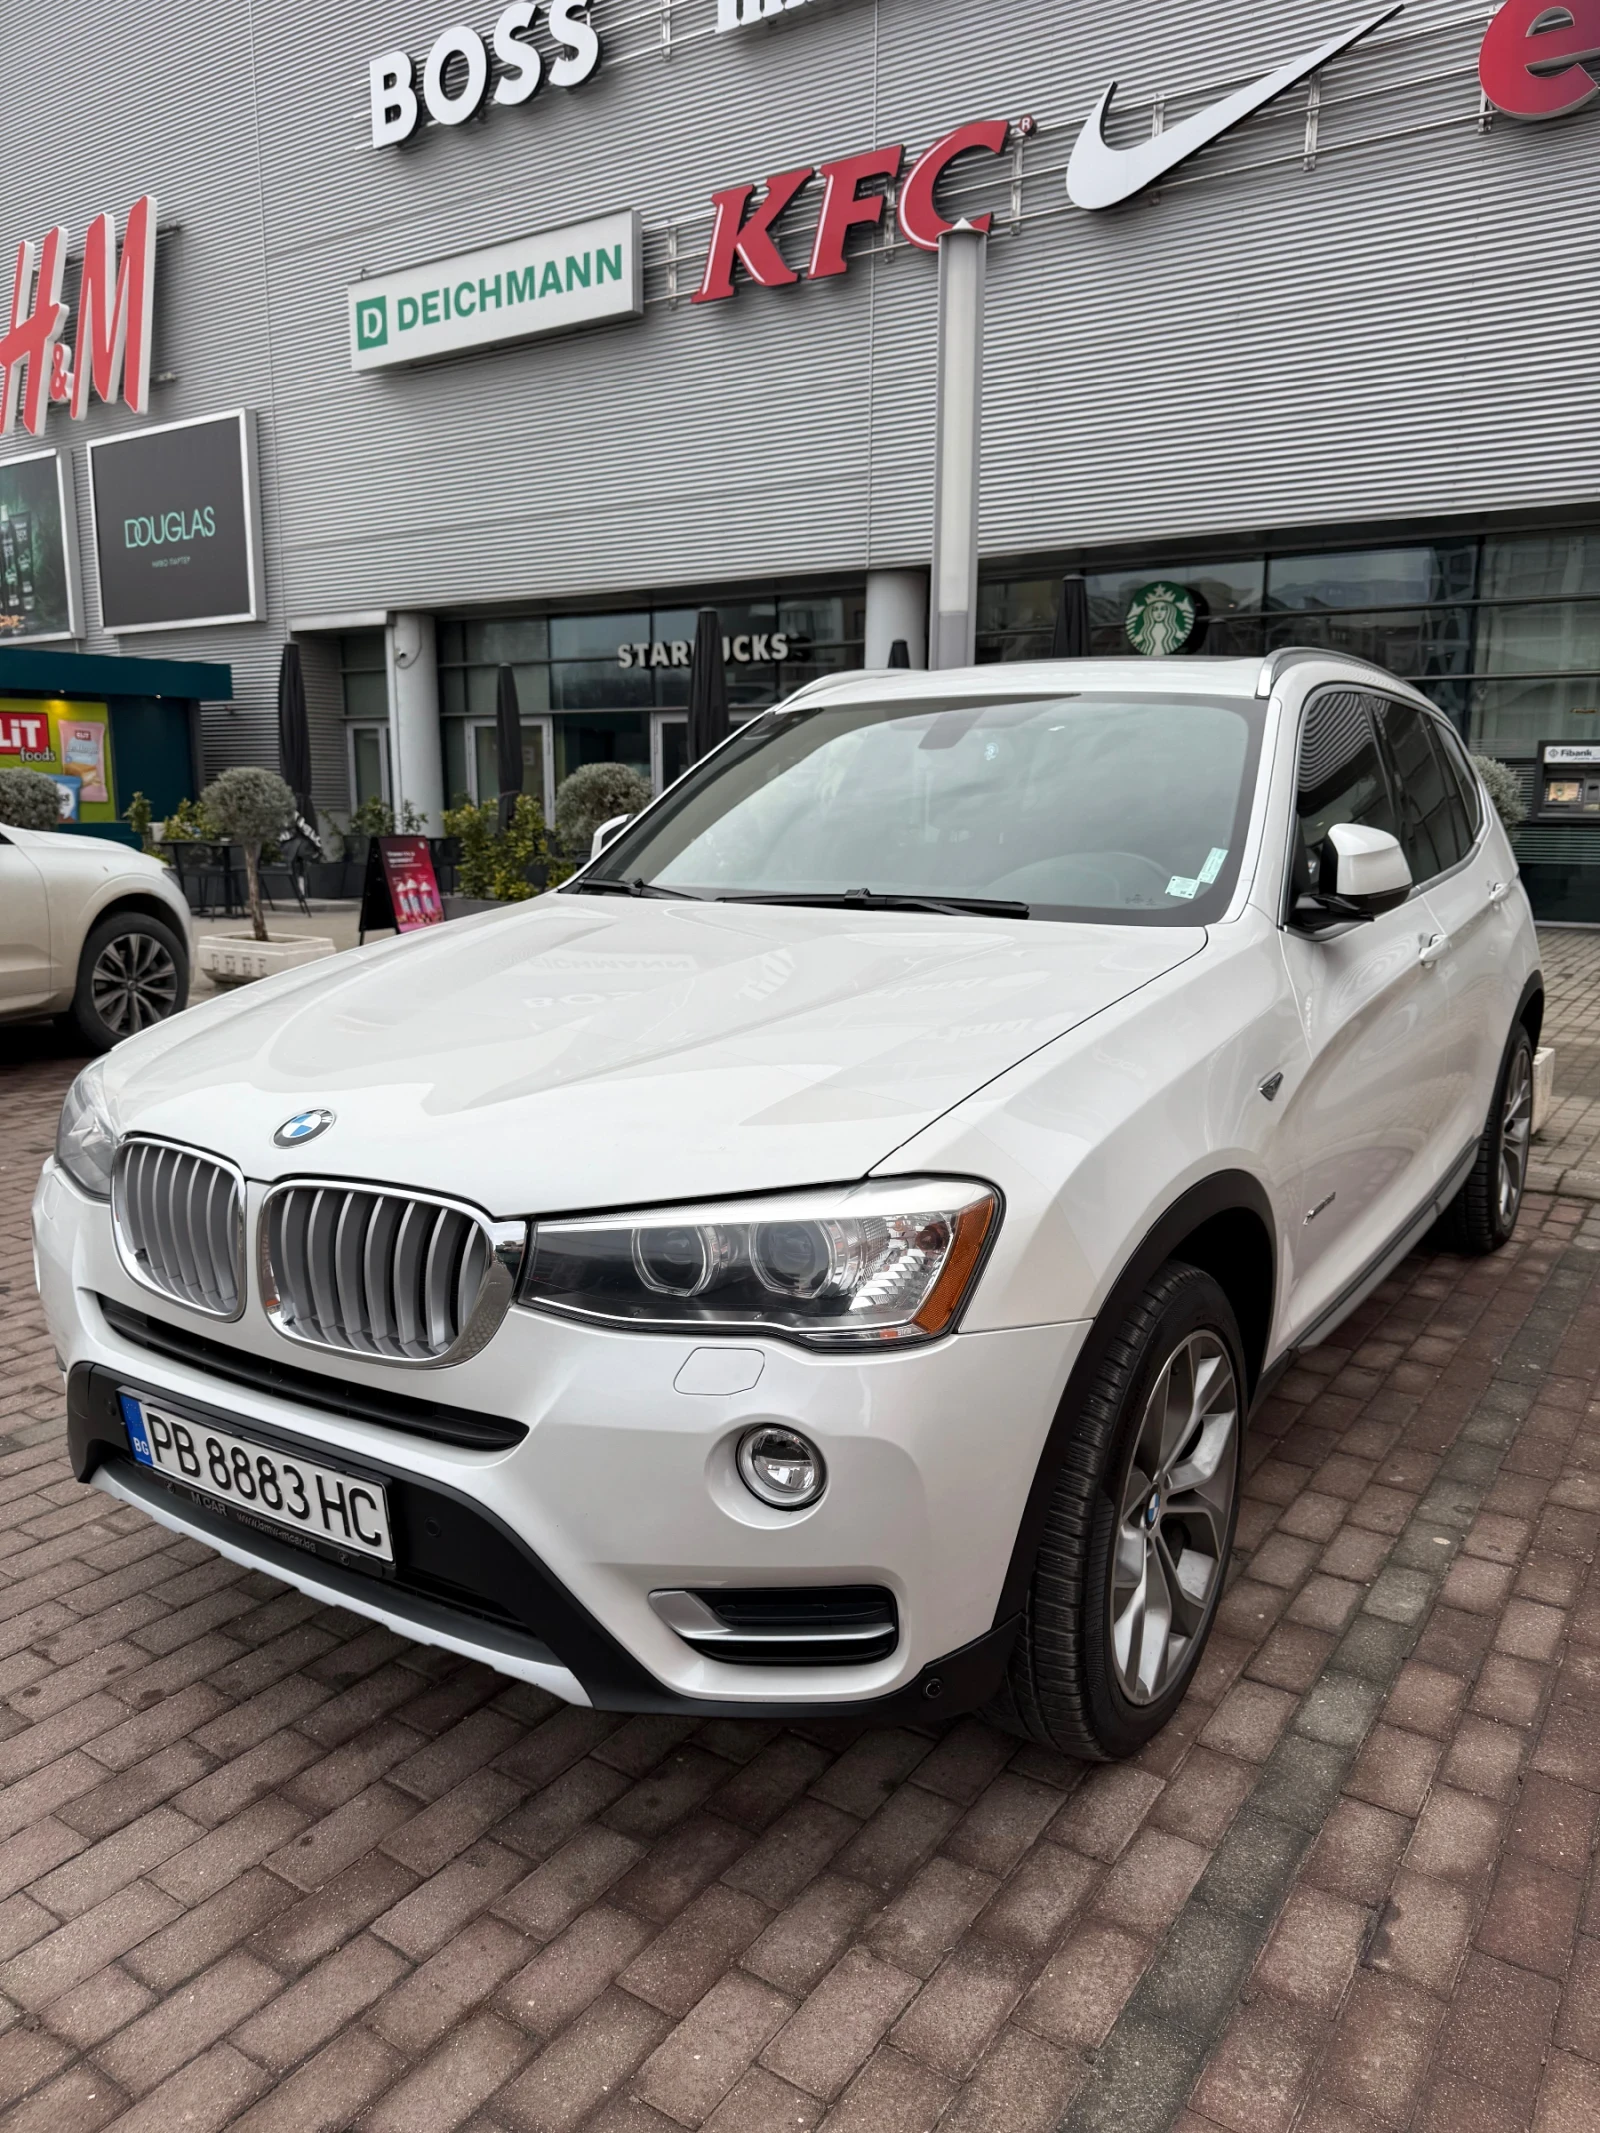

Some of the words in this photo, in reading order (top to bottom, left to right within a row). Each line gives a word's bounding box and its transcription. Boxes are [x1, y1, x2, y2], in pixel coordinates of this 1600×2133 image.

[370, 0, 600, 149] BOSS
[691, 119, 1010, 303] KFC
[0, 195, 157, 437] H&M
[397, 243, 623, 332] DEICHMANN
[124, 505, 216, 549] DOUGLAS
[20, 746, 56, 762] foods
[1560, 749, 1593, 757] Fibank
[132, 1437, 150, 1456] BG
[146, 1411, 201, 1478] PB
[205, 1436, 311, 1521] 8883
[315, 1474, 383, 1547] HC
[203, 1497, 228, 1517] CAR
